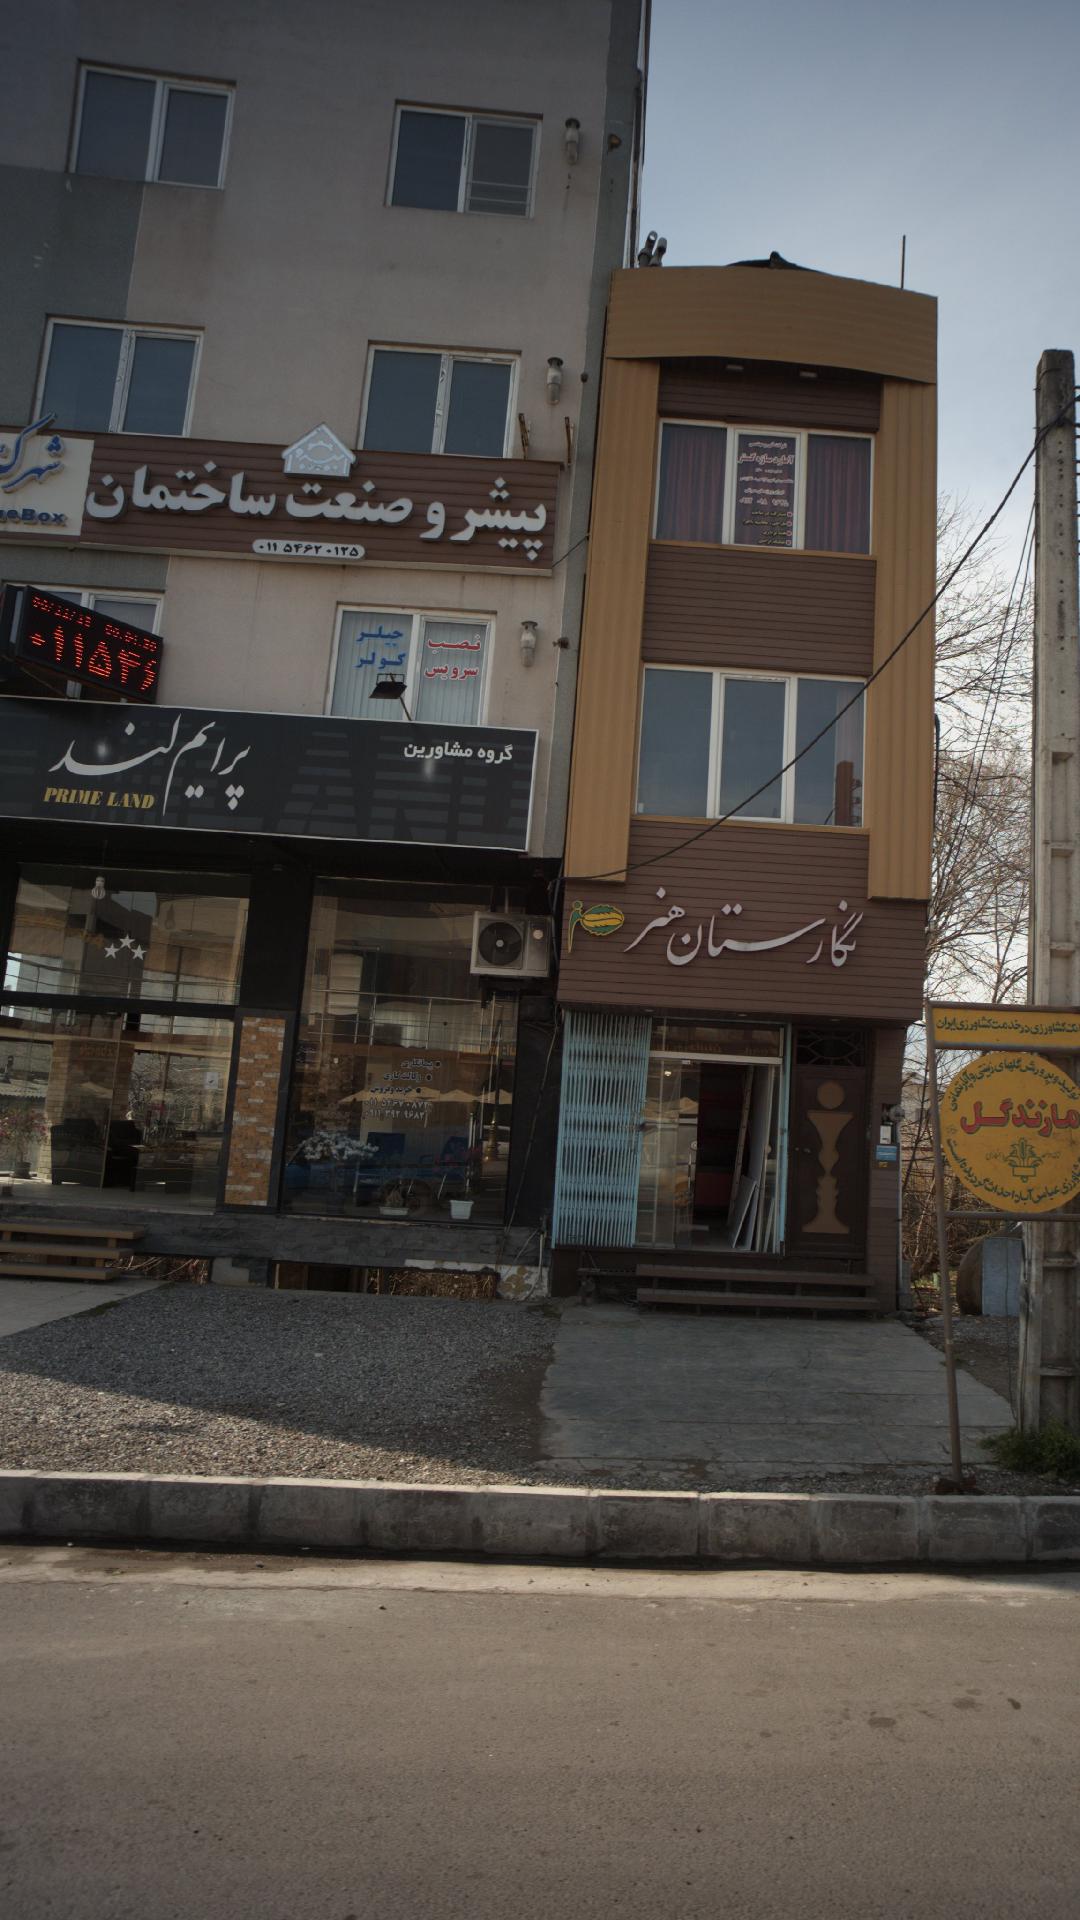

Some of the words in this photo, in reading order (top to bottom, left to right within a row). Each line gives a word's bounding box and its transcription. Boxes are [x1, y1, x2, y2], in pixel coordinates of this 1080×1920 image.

[86, 460, 276, 518] ساختمان
[285, 480, 413, 523] صنعت
[428, 633, 481, 655] نصب
[425, 664, 479, 680] سرویس
[48, 713, 182, 776] لند
[404, 741, 473, 759] مشاورین
[477, 743, 513, 764] گروه
[43, 787, 103, 806] PRIME
[106, 792, 155, 809] LAND
[623, 887, 686, 953] هنر
[666, 899, 864, 967] نگارستان
